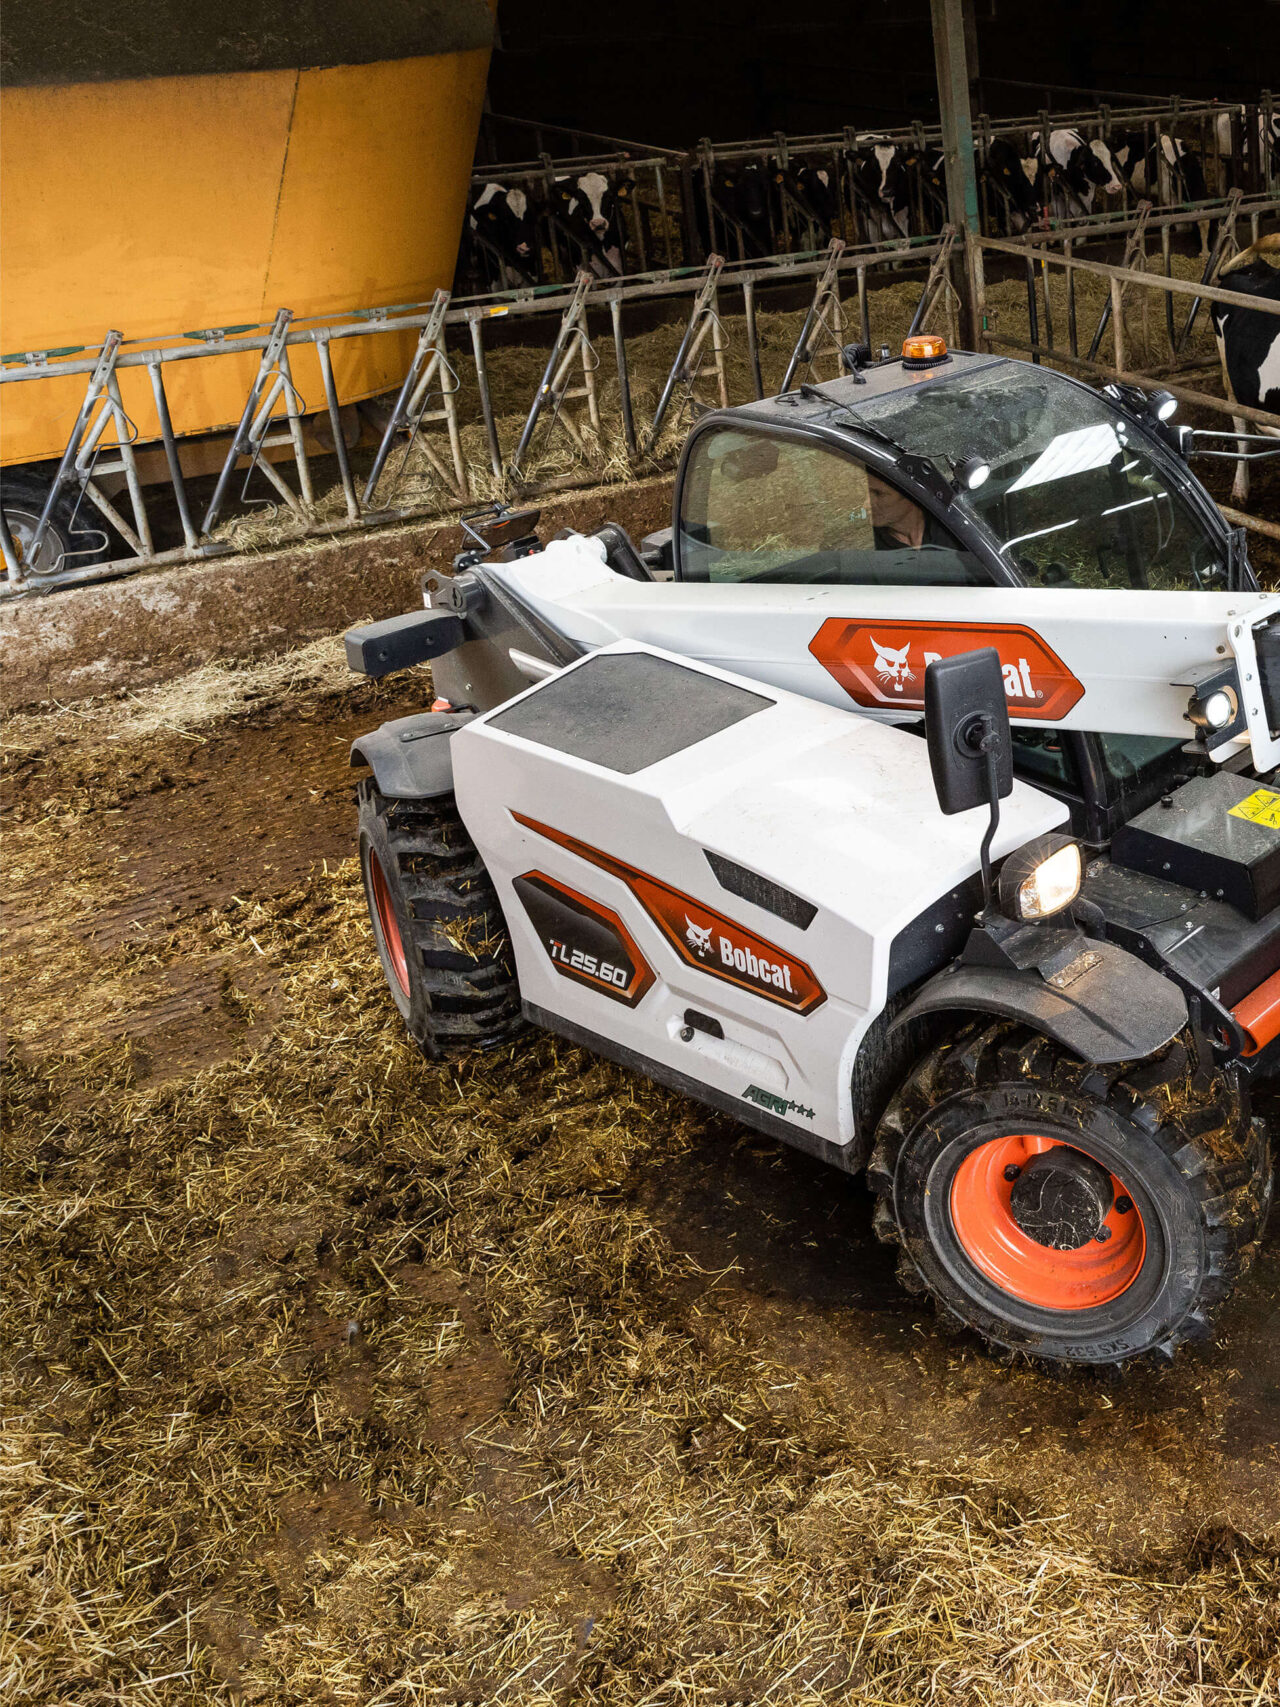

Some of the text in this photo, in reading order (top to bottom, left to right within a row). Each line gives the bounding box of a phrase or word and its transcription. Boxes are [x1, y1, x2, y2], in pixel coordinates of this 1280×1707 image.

[549, 939, 627, 988] TL25.60
[719, 936, 793, 993] Bobcat
[741, 1084, 788, 1116] AGRI
